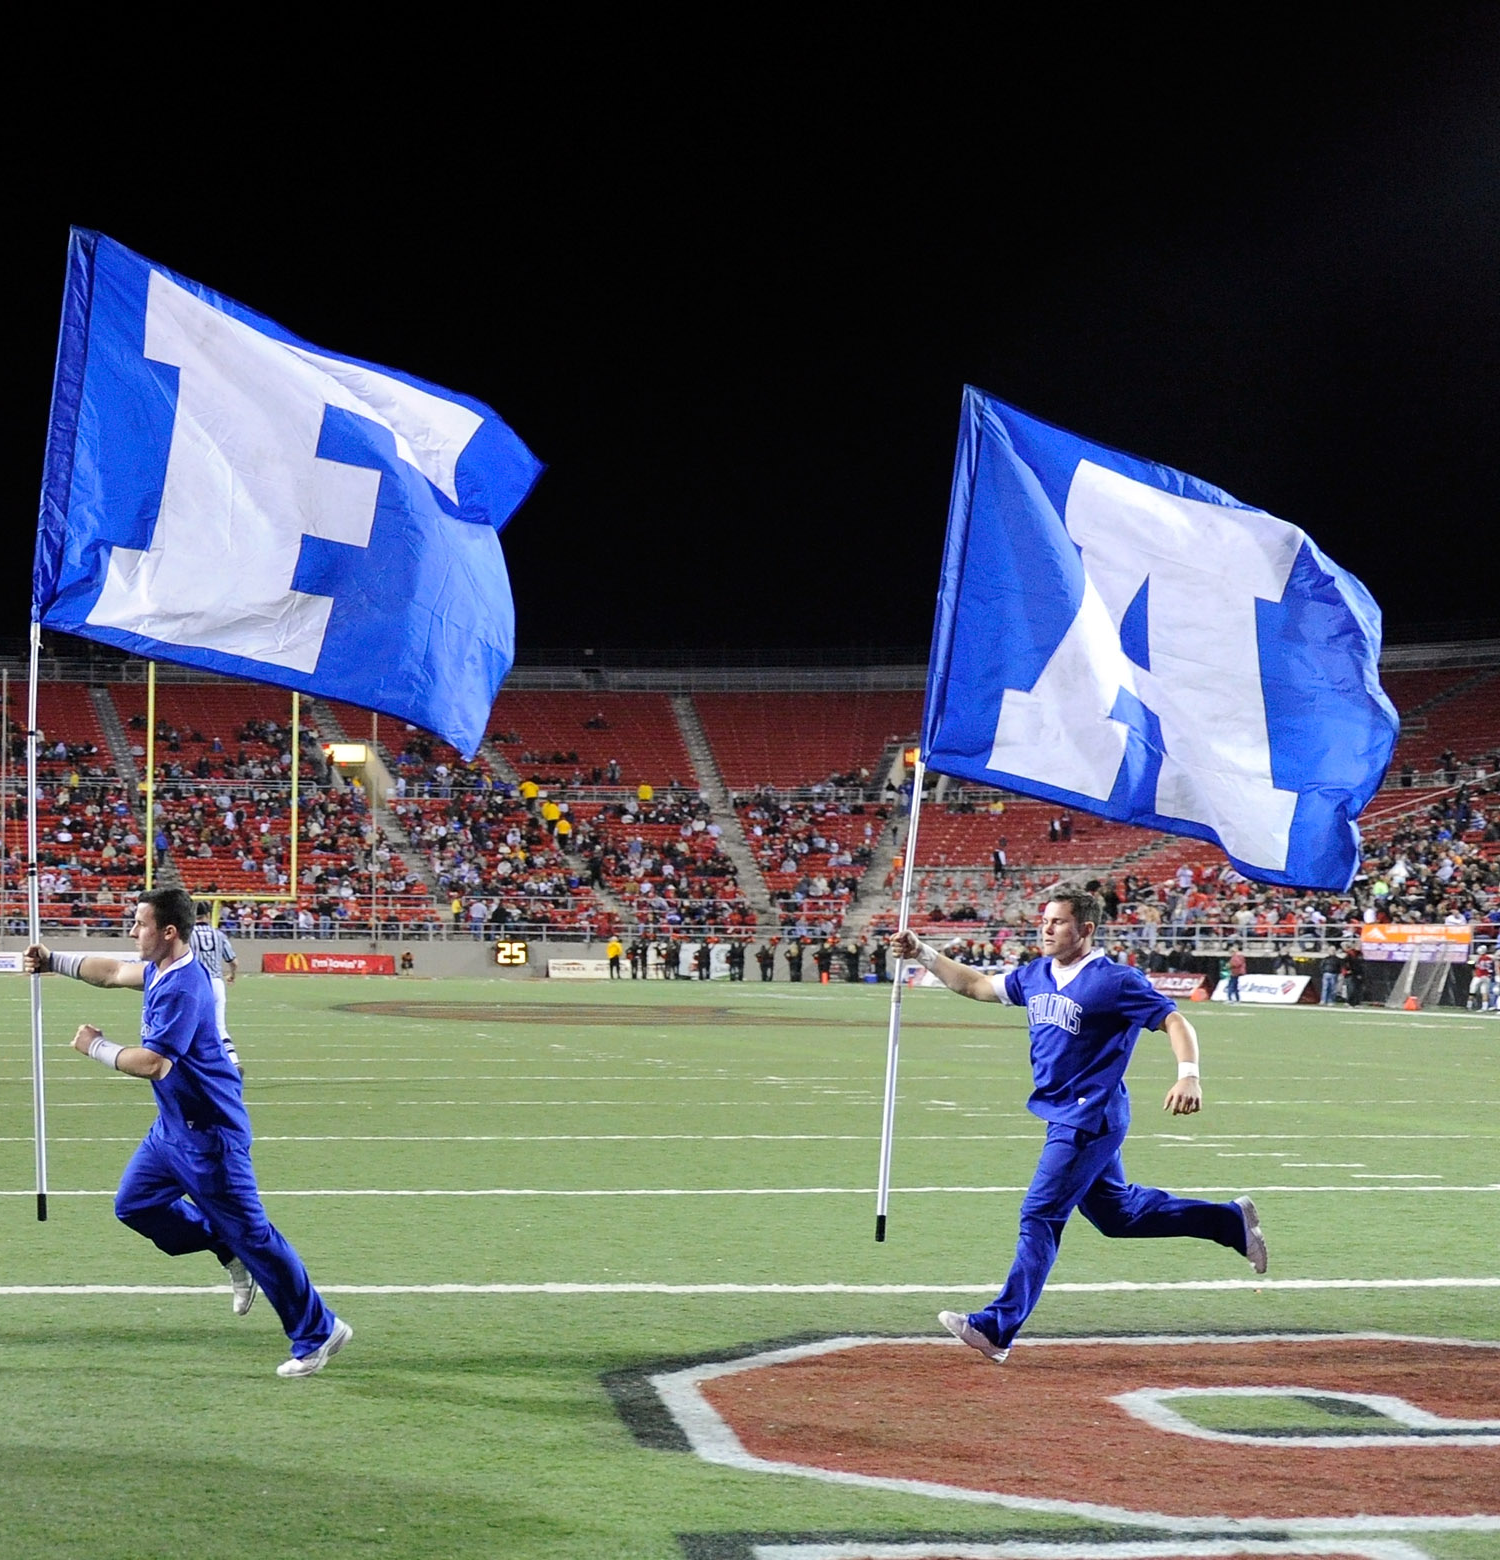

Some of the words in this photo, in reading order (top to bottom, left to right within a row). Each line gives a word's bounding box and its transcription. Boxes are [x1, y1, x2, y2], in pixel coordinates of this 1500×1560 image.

[85, 269, 484, 674] F
[986, 458, 1304, 871] A
[198, 930, 215, 951] U
[497, 942, 527, 965] 25
[1028, 993, 1083, 1036] FALCONS
